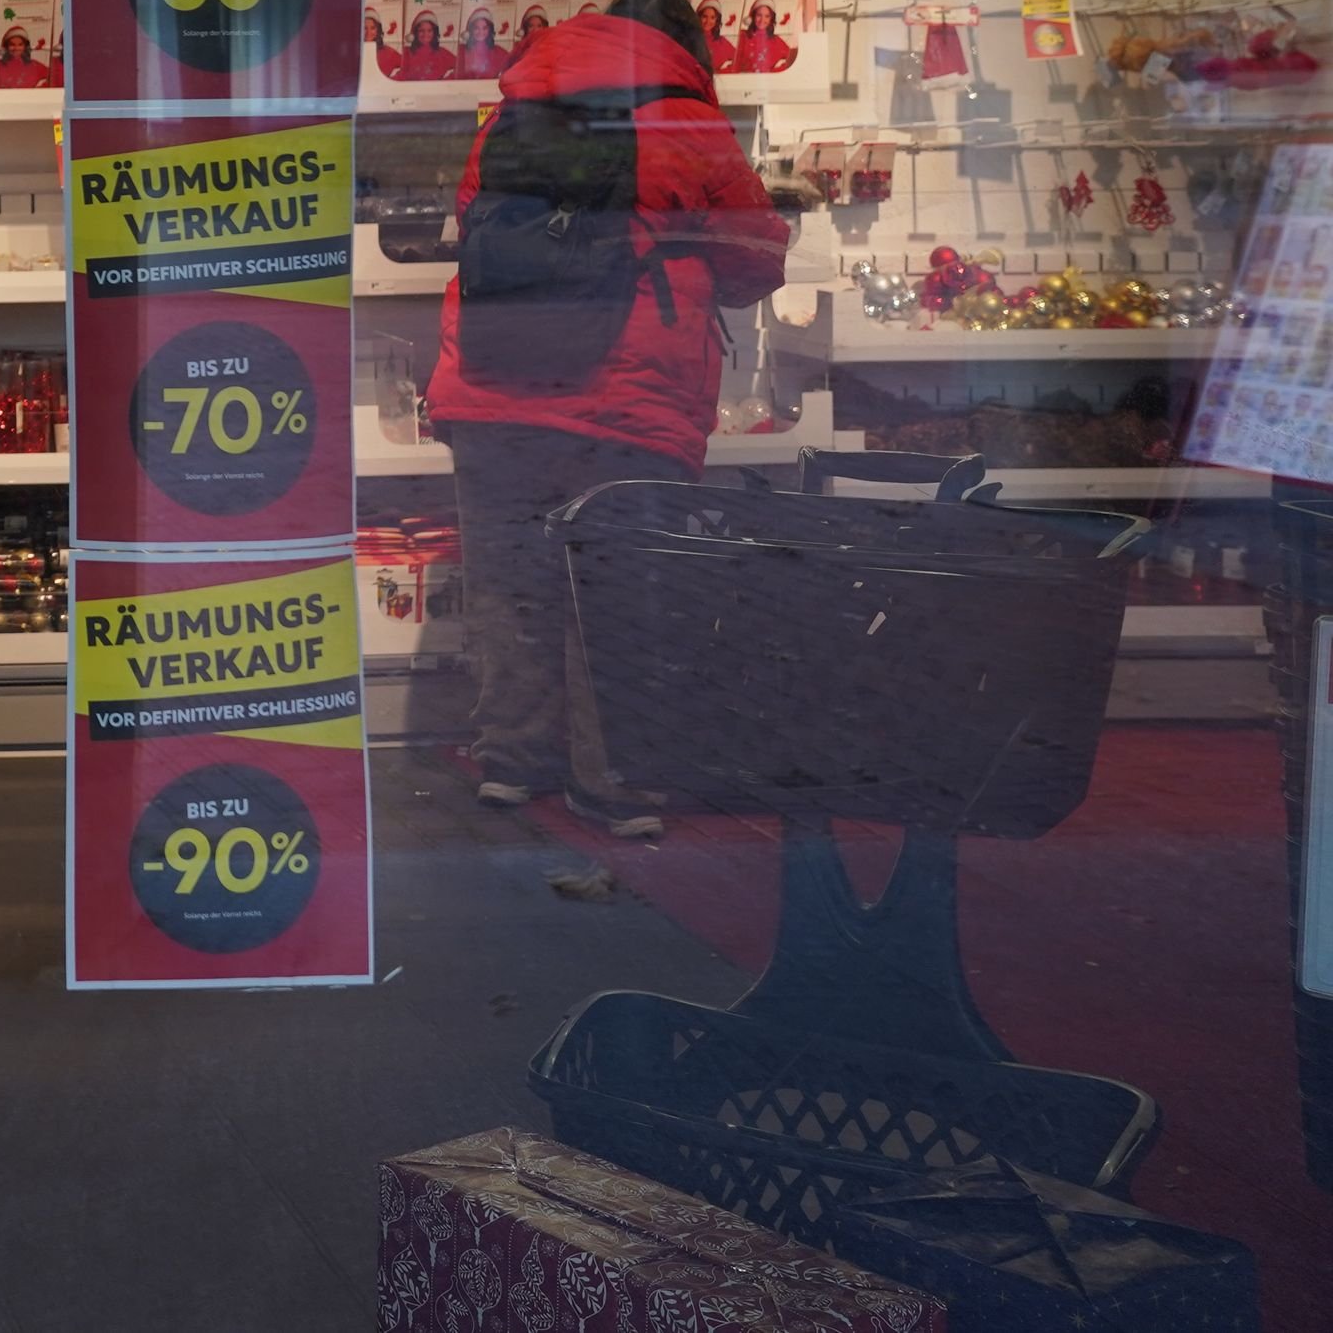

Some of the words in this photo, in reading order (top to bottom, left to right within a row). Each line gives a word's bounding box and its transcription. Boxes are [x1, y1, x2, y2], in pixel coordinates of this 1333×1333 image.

[81, 151, 335, 205] RÄUMUNGS-
[124, 194, 319, 245] VERKAUF
[94, 269, 133, 285] VOR
[137, 260, 242, 282] DEFINITIVER
[246, 251, 347, 276] SCHLIESSUNG
[187, 359, 217, 378] BIS
[223, 358, 248, 375] ZU
[143, 386, 308, 455] -70%
[85, 593, 341, 647] RÄUMUNGS-
[127, 637, 324, 688] VERKAUF
[97, 712, 135, 728] VOR
[139, 703, 245, 726] DEFINITIVER
[248, 690, 357, 719] SCHLIESSUNG
[187, 802, 218, 819] BIS
[222, 799, 249, 817] ZU
[143, 827, 309, 895] -90%
